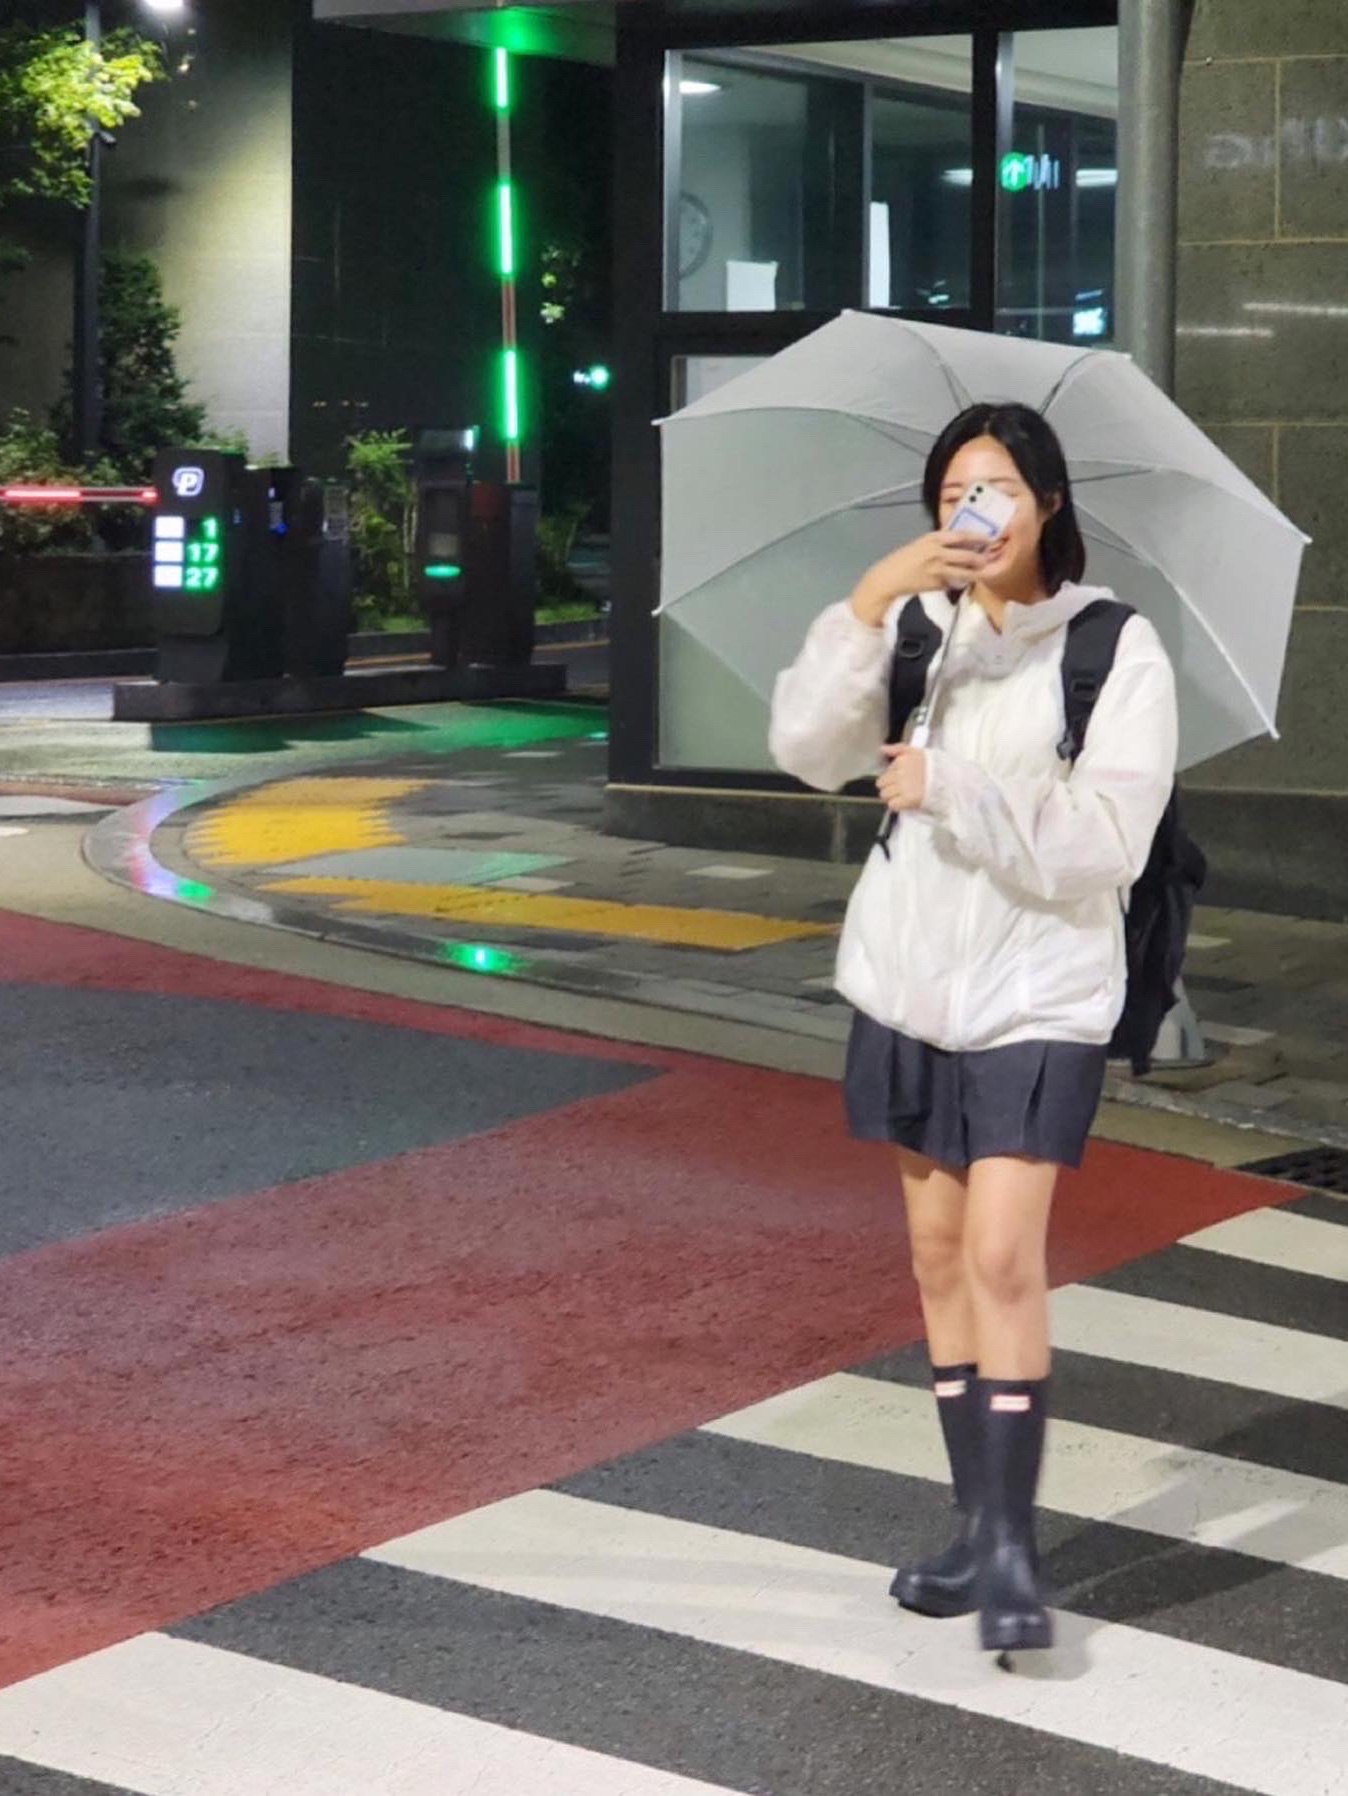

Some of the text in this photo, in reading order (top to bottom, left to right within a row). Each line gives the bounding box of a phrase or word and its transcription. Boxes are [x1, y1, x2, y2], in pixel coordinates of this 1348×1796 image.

[203, 517, 217, 539] 1
[187, 543, 218, 562] 17
[186, 567, 218, 588] 27
